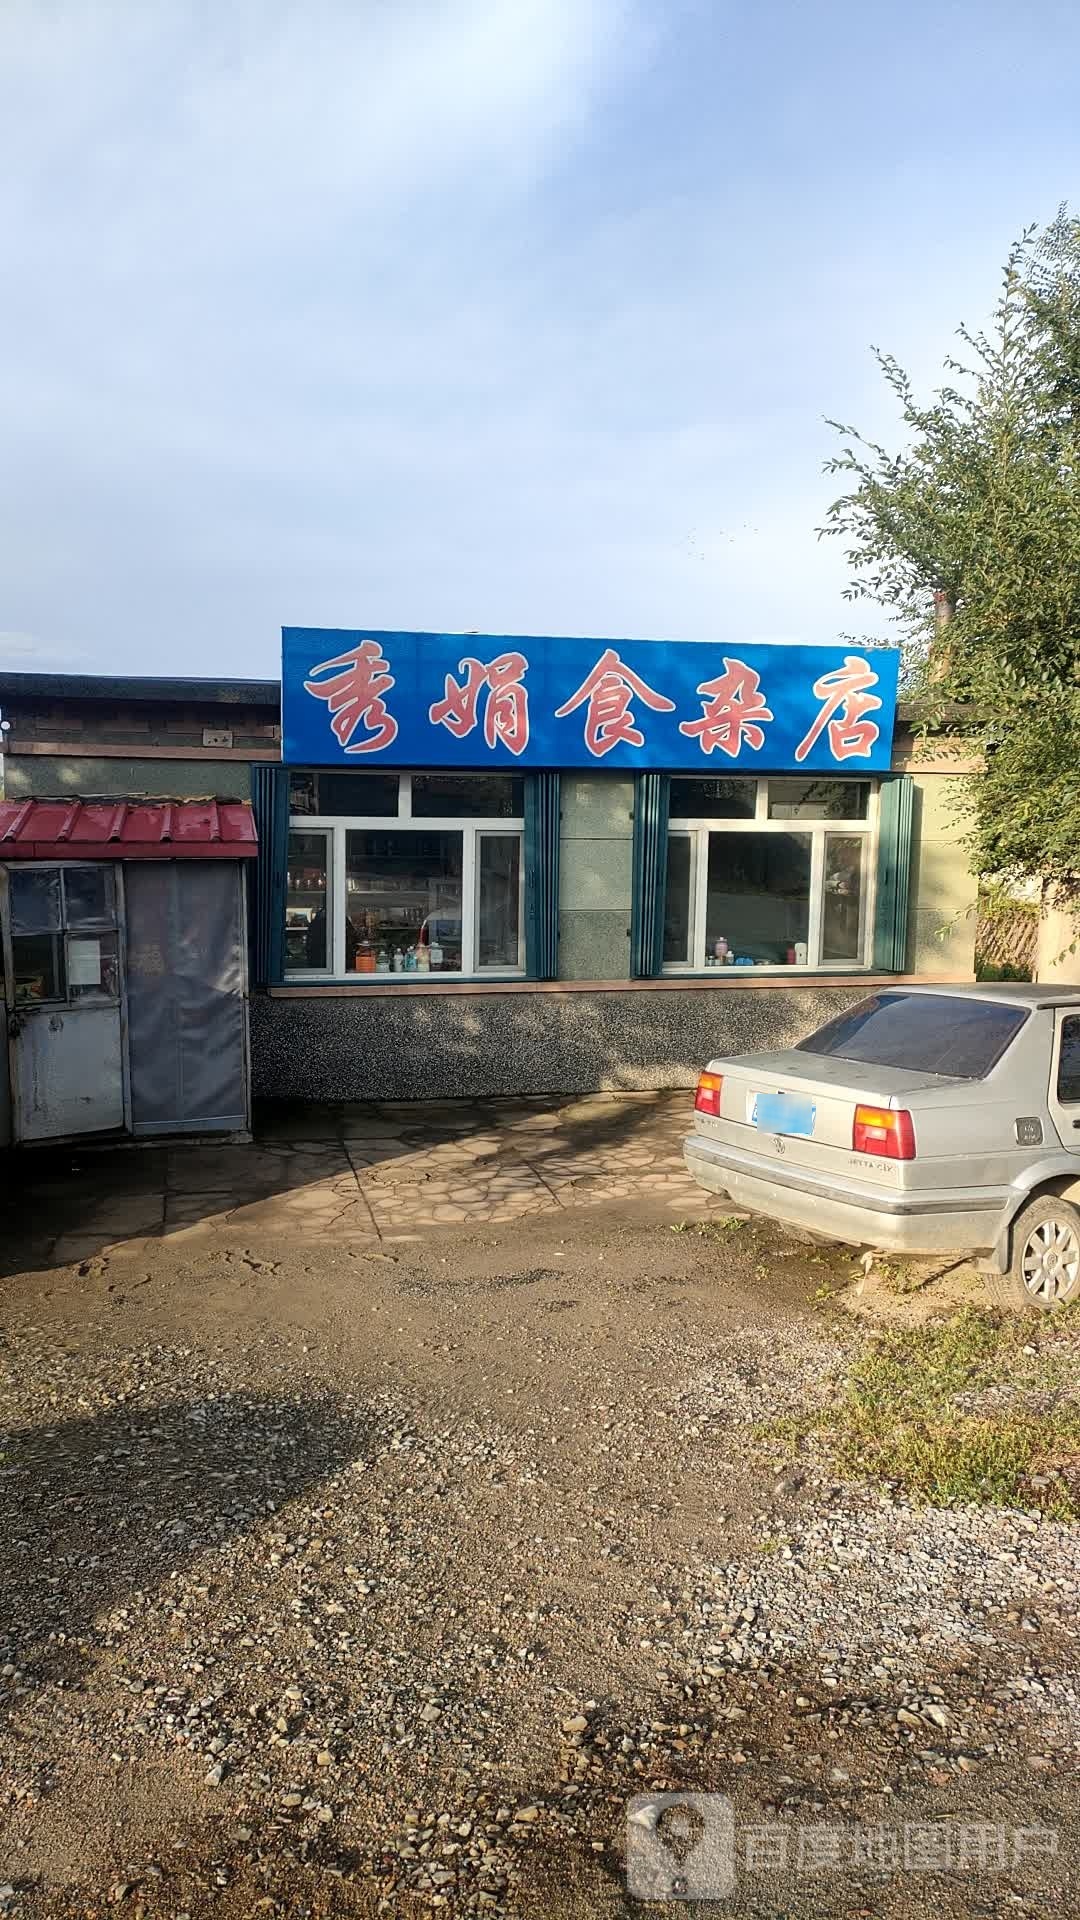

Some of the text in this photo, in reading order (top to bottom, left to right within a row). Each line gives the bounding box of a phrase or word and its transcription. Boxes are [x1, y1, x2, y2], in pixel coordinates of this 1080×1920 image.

[303, 639, 882, 761] 秀娟食杂店
